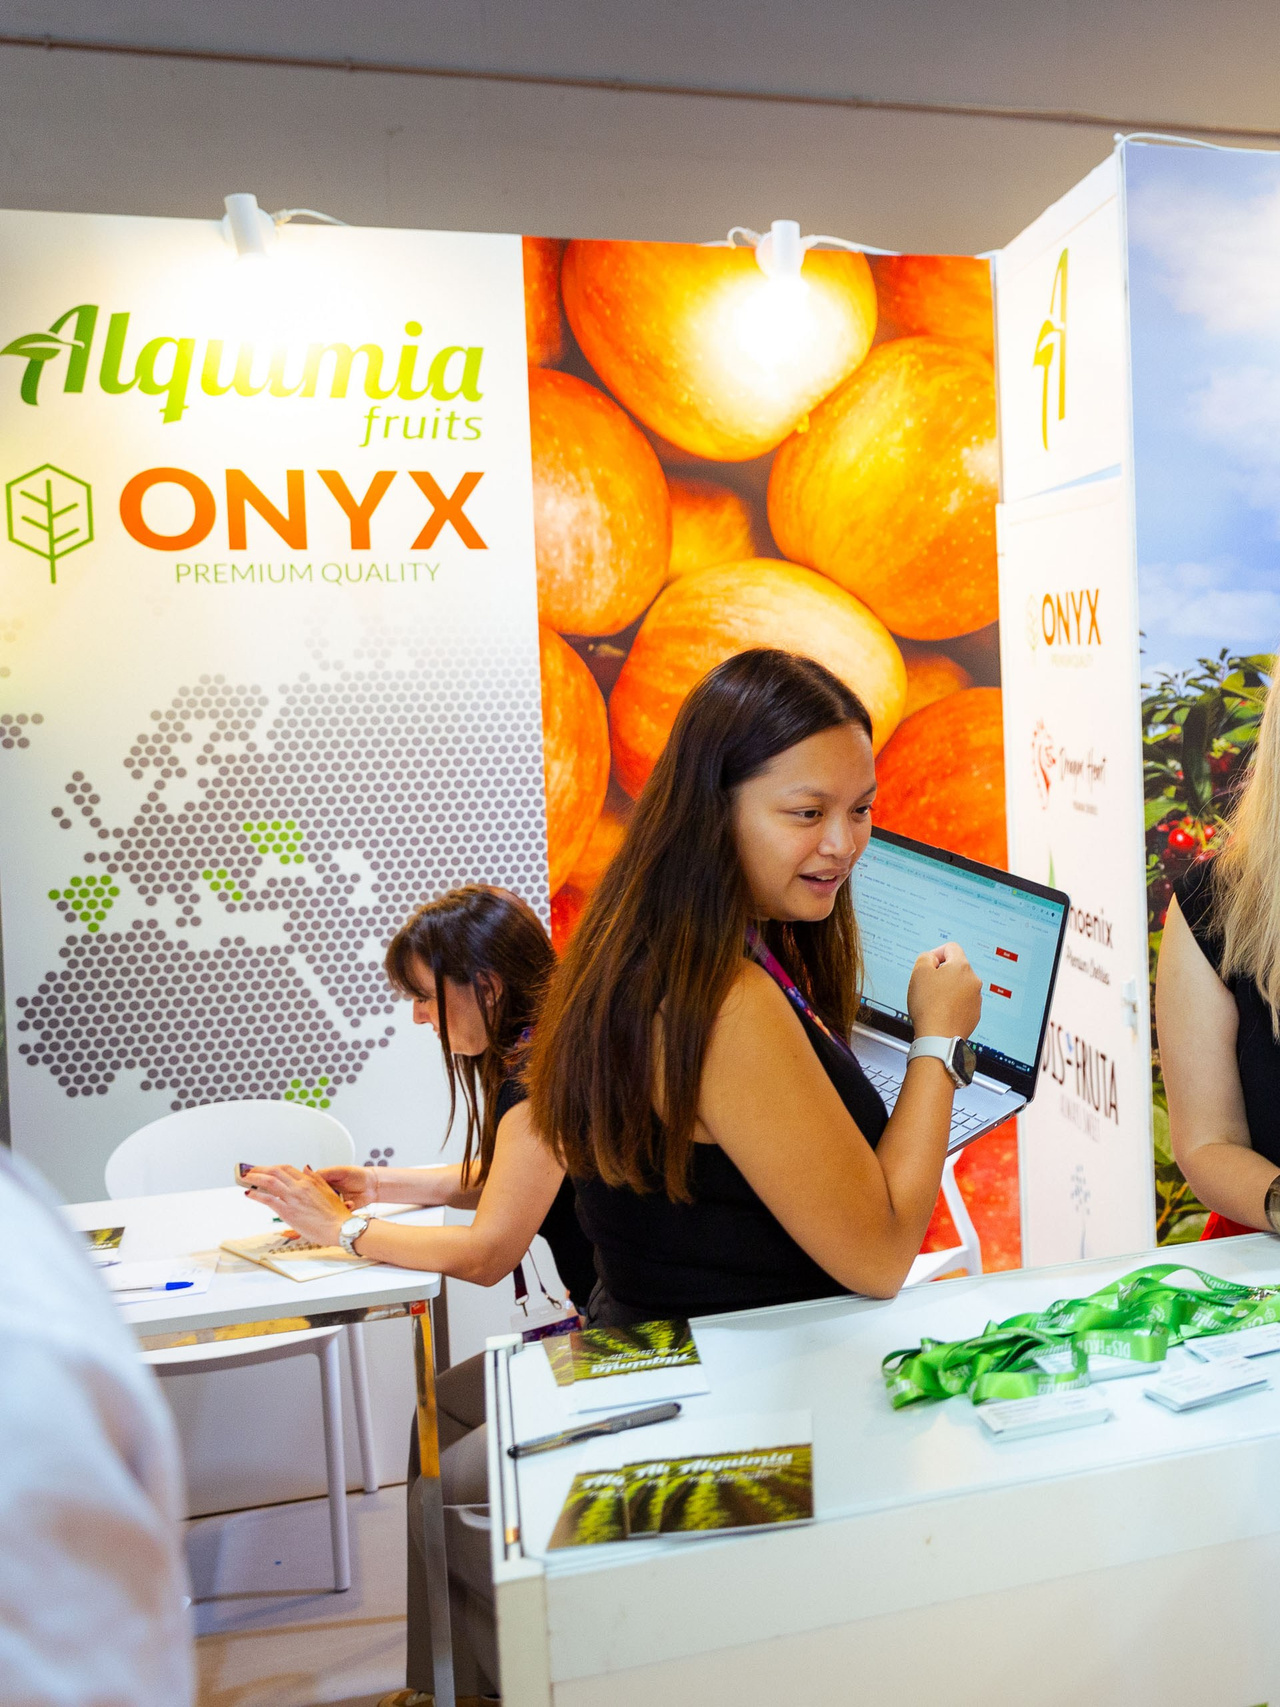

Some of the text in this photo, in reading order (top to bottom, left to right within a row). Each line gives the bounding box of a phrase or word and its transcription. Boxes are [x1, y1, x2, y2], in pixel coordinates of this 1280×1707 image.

[0, 304, 484, 424] Alquimia
[359, 406, 483, 447] fruits
[119, 467, 489, 551] ONYX
[175, 562, 441, 585] PREMIUM QUALITY
[1042, 588, 1102, 646] ONYX
[1067, 906, 1113, 950] hoenix
